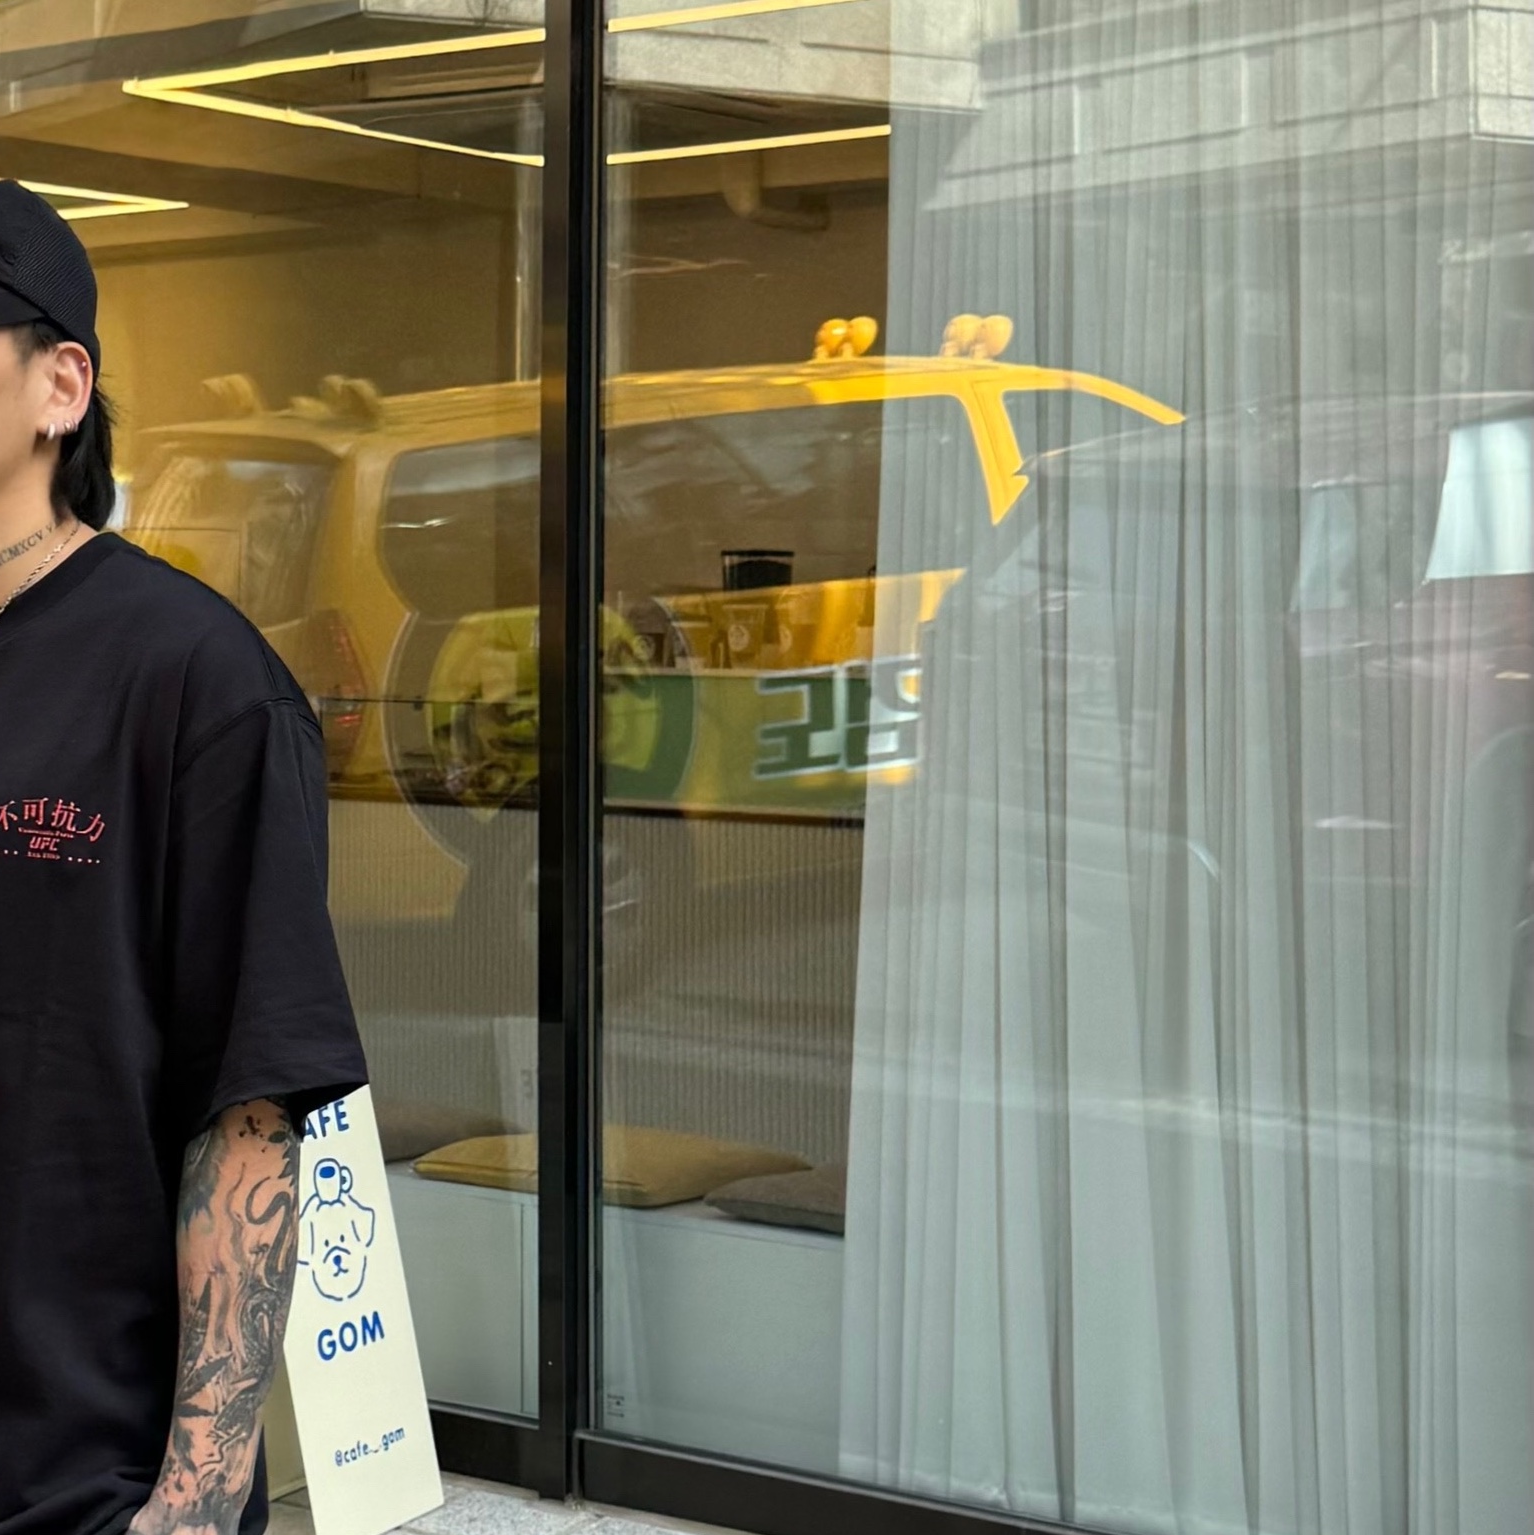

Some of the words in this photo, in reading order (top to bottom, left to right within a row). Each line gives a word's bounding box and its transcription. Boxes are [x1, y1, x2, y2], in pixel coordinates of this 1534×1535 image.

[29, 836, 60, 851] UFC
[304, 1100, 349, 1140] AFE
[318, 1310, 385, 1361] GOM
